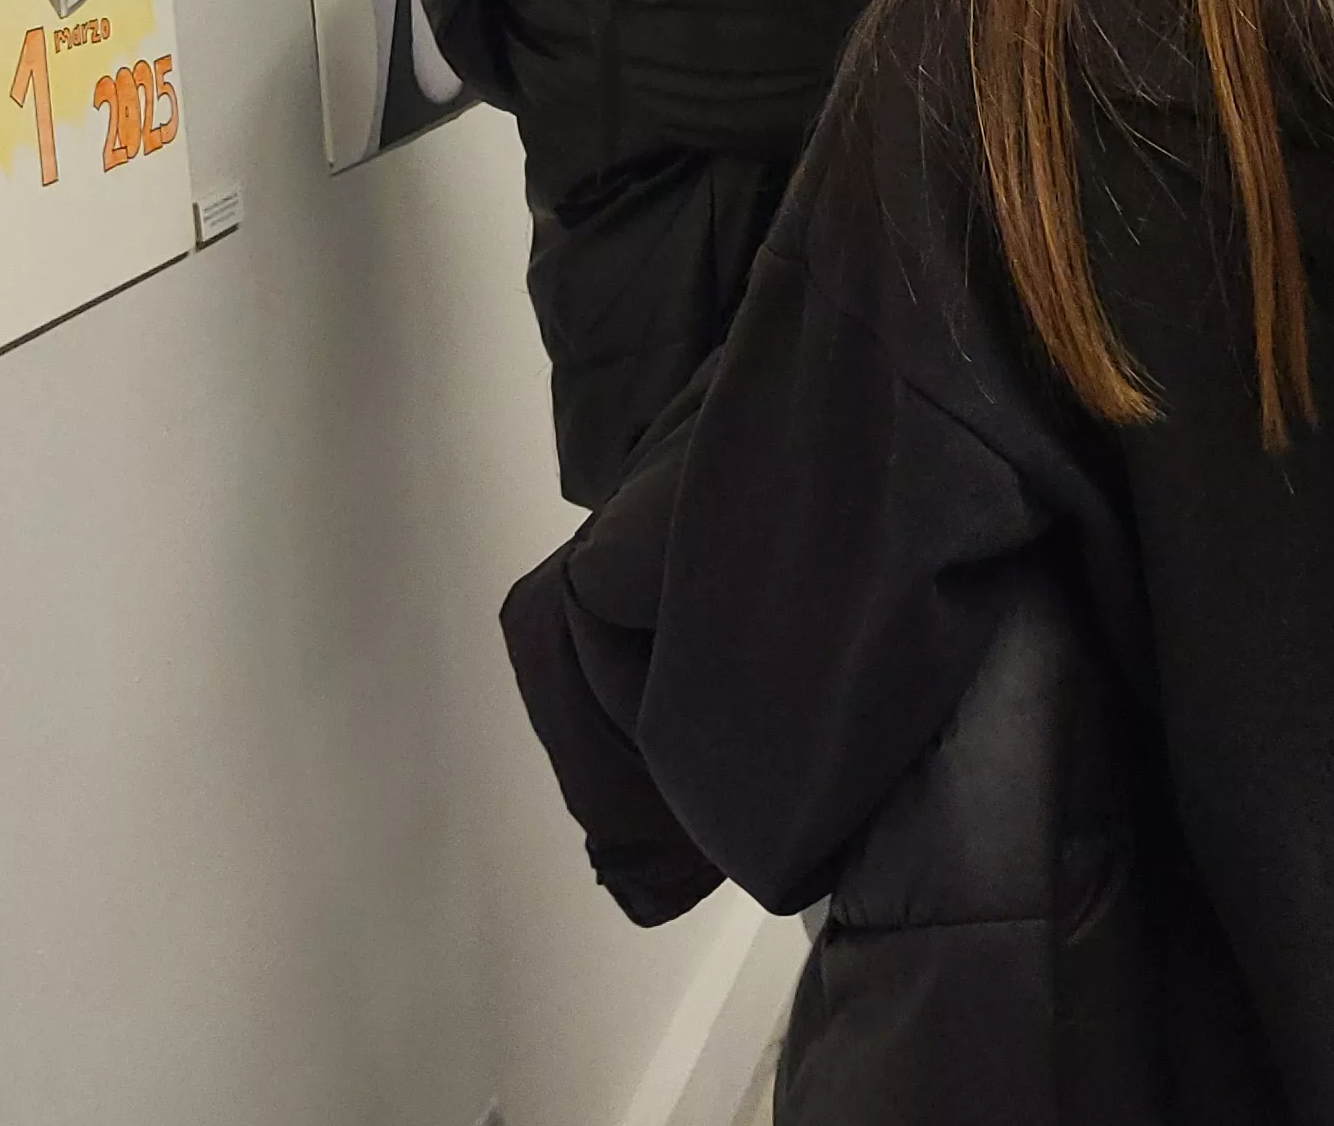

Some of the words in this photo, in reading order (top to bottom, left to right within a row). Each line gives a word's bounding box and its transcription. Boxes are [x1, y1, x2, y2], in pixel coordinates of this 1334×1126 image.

[10, 26, 59, 187] 1
[54, 17, 111, 54] marzo
[93, 53, 180, 173] 2025
